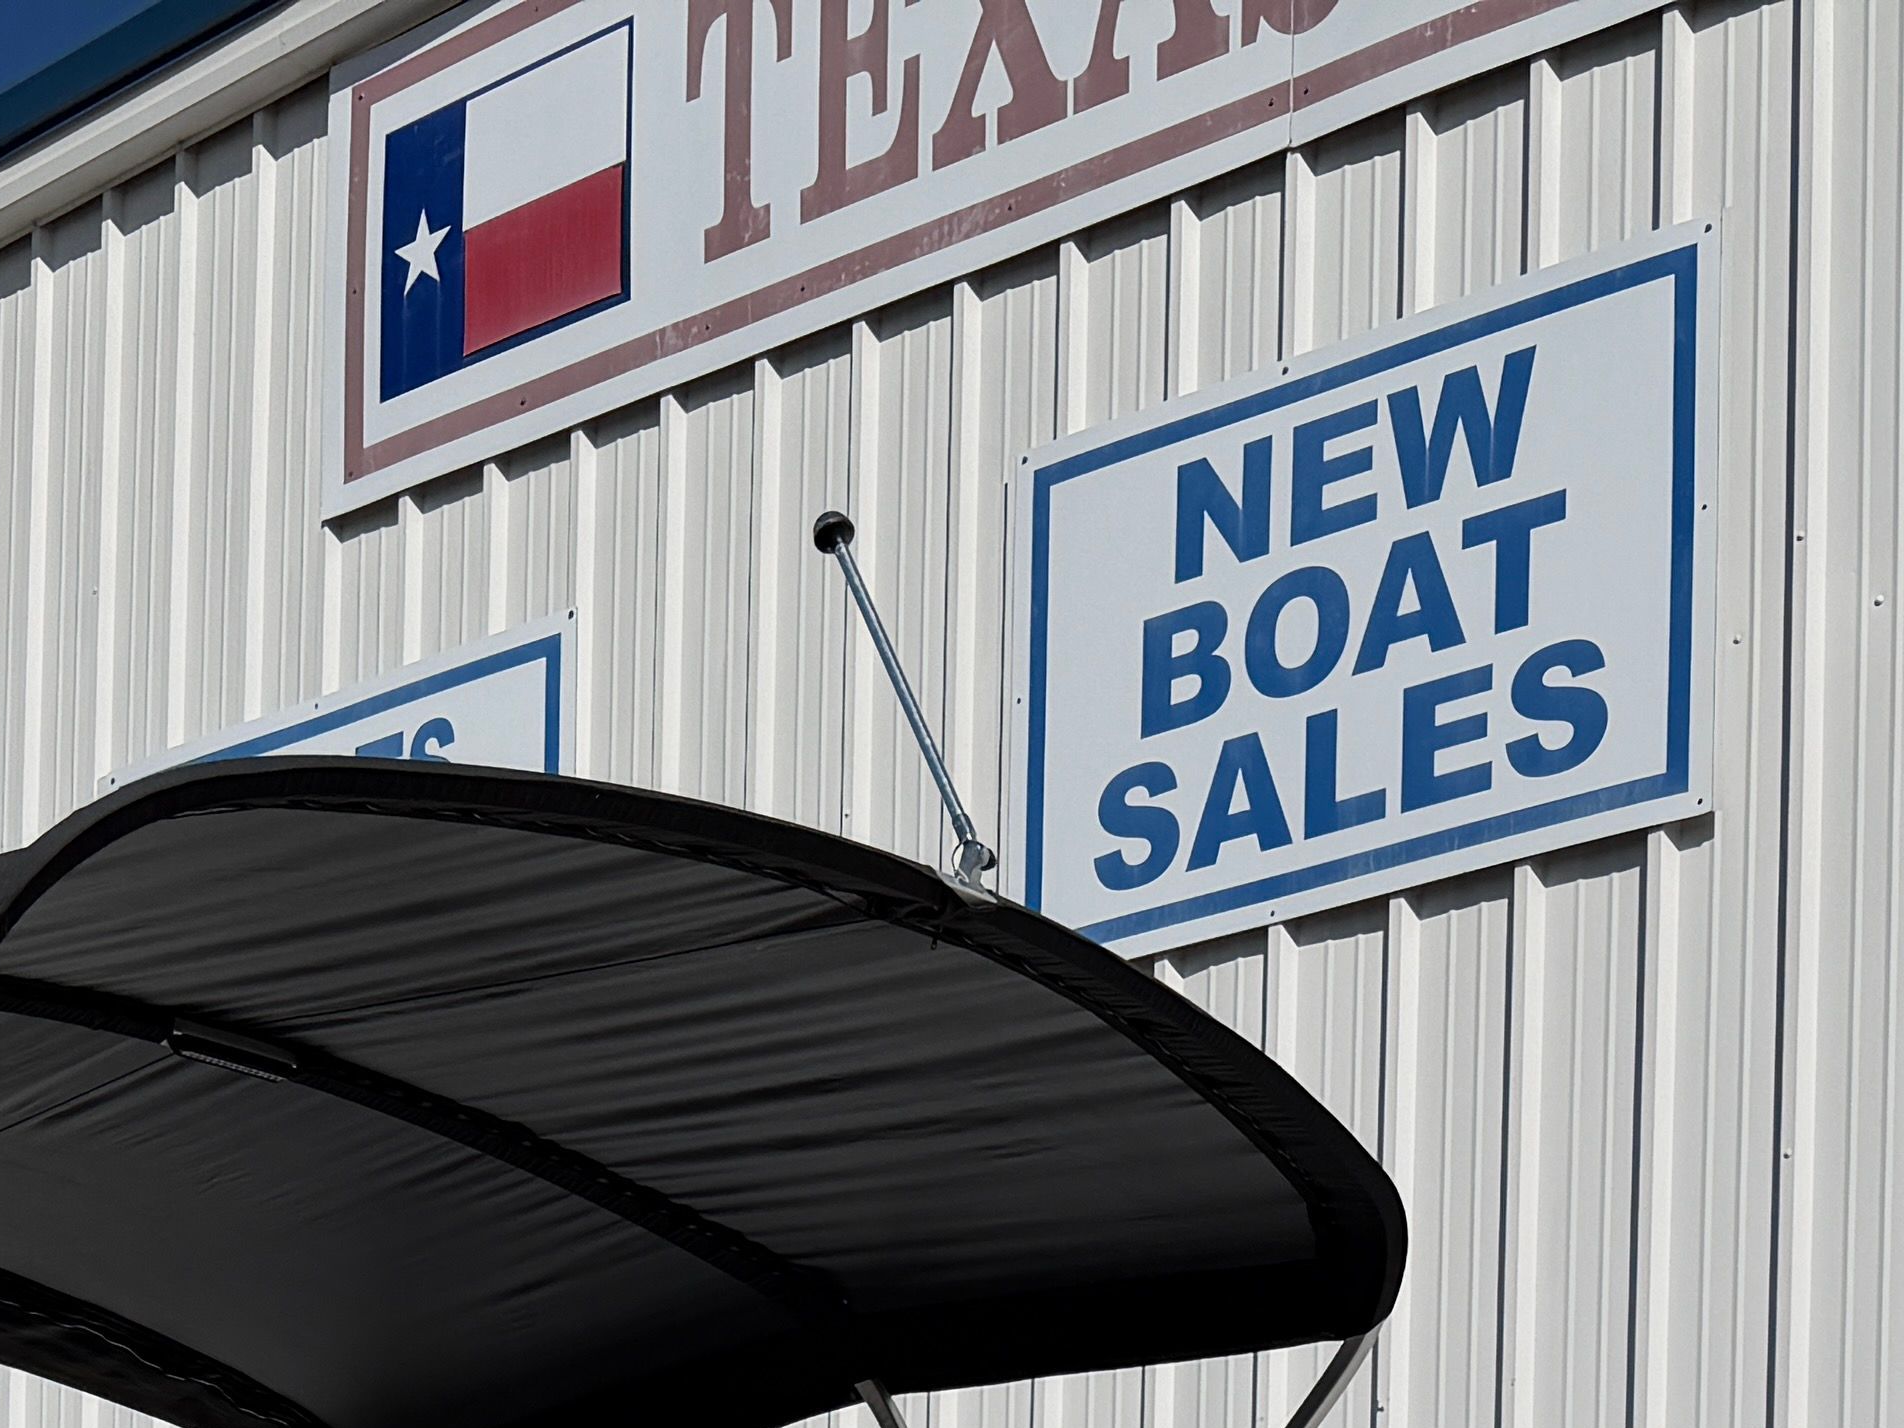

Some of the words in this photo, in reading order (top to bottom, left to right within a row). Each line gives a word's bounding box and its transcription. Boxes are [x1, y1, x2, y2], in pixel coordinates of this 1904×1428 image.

[1175, 344, 1537, 584] NEW
[1141, 488, 1567, 740] BOAT
[1093, 638, 1609, 891] SALES
